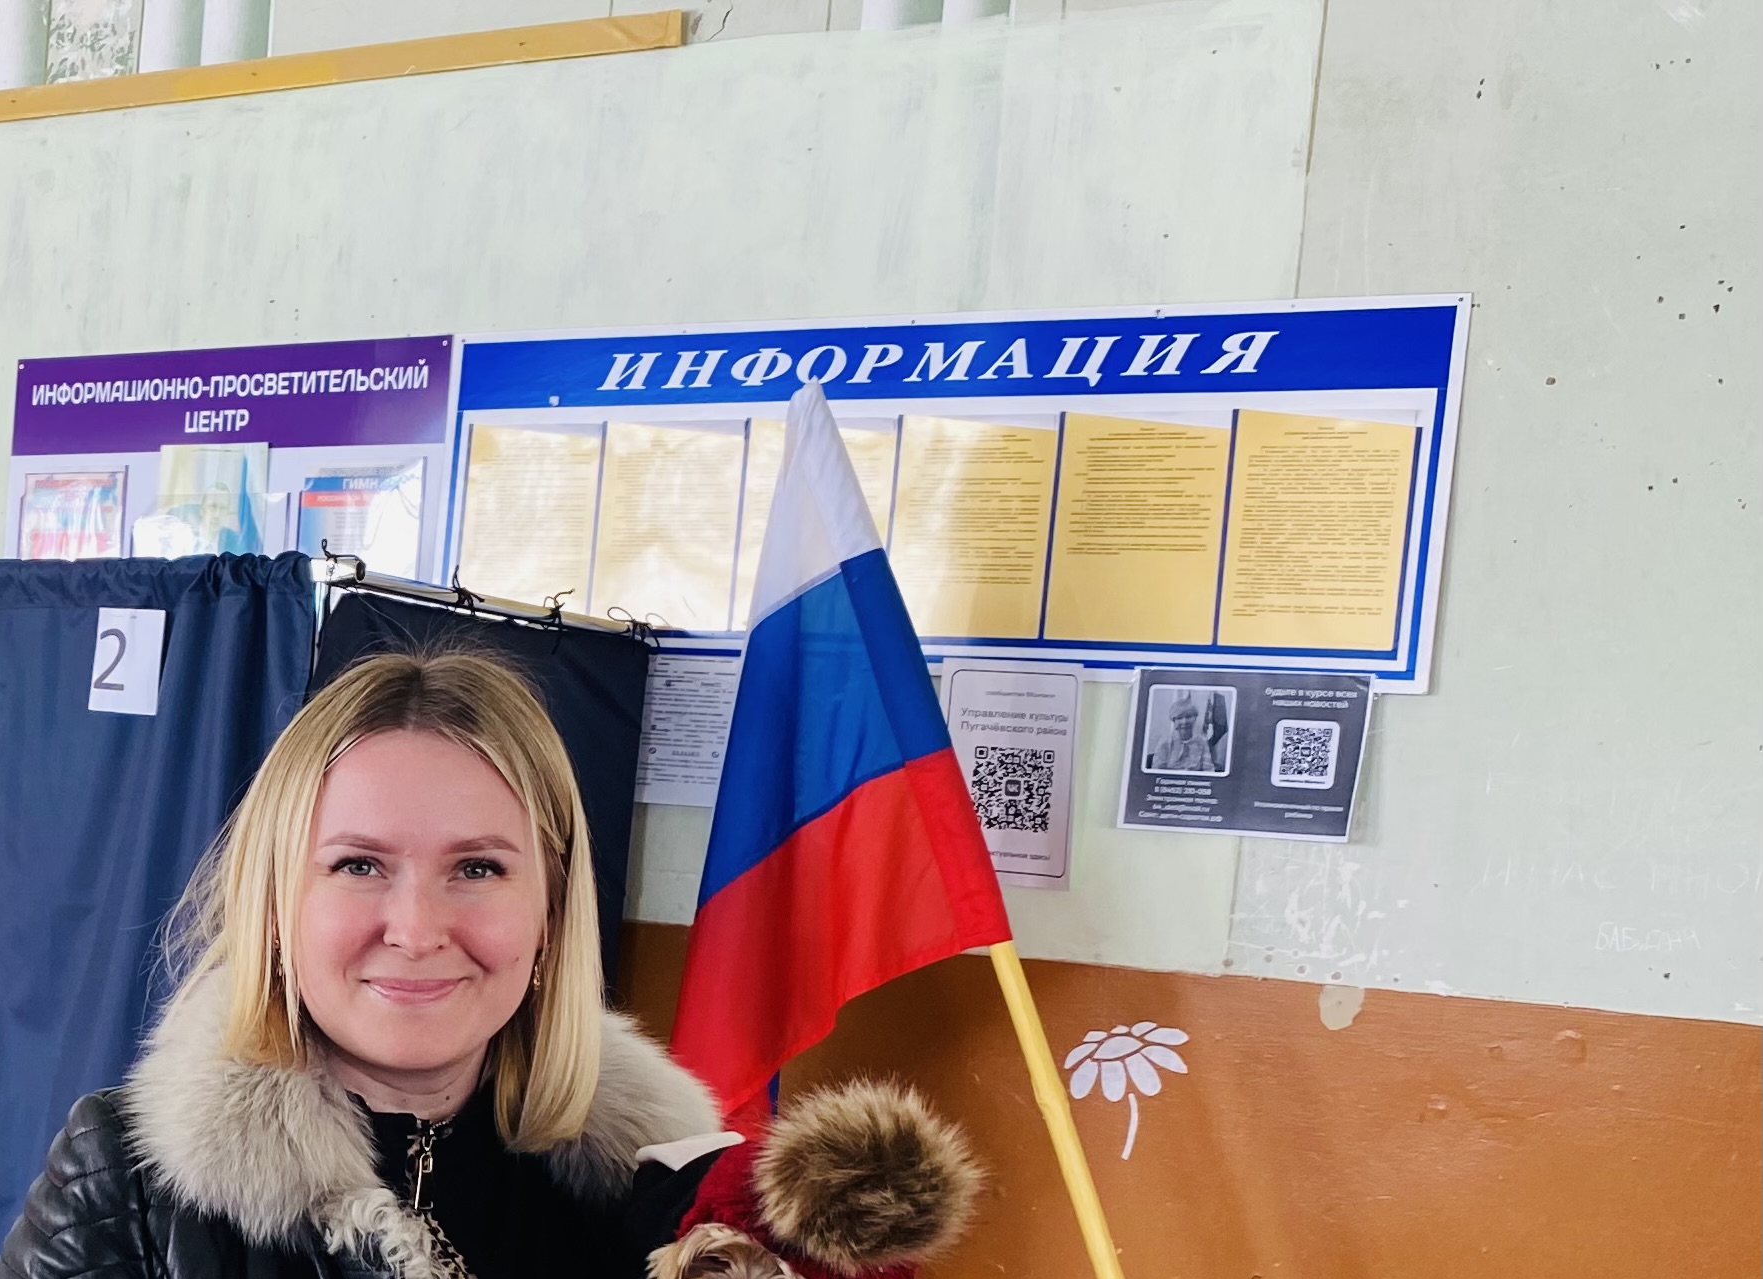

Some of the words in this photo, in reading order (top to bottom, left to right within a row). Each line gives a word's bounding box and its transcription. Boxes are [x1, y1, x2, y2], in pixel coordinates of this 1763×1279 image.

[597, 331, 1281, 390] ИНФОРМАЦИЯ
[31, 358, 430, 406] ИНФОРМАЦИОННО-ПРОСВЕТИТЕЛЬСКИЙ
[184, 408, 251, 433] ЦЕНТР
[342, 478, 378, 491] ГИМН
[93, 628, 127, 692] 2
[961, 707, 1027, 719] Управление
[1028, 712, 1069, 723] культуры
[1036, 726, 1067, 736] района
